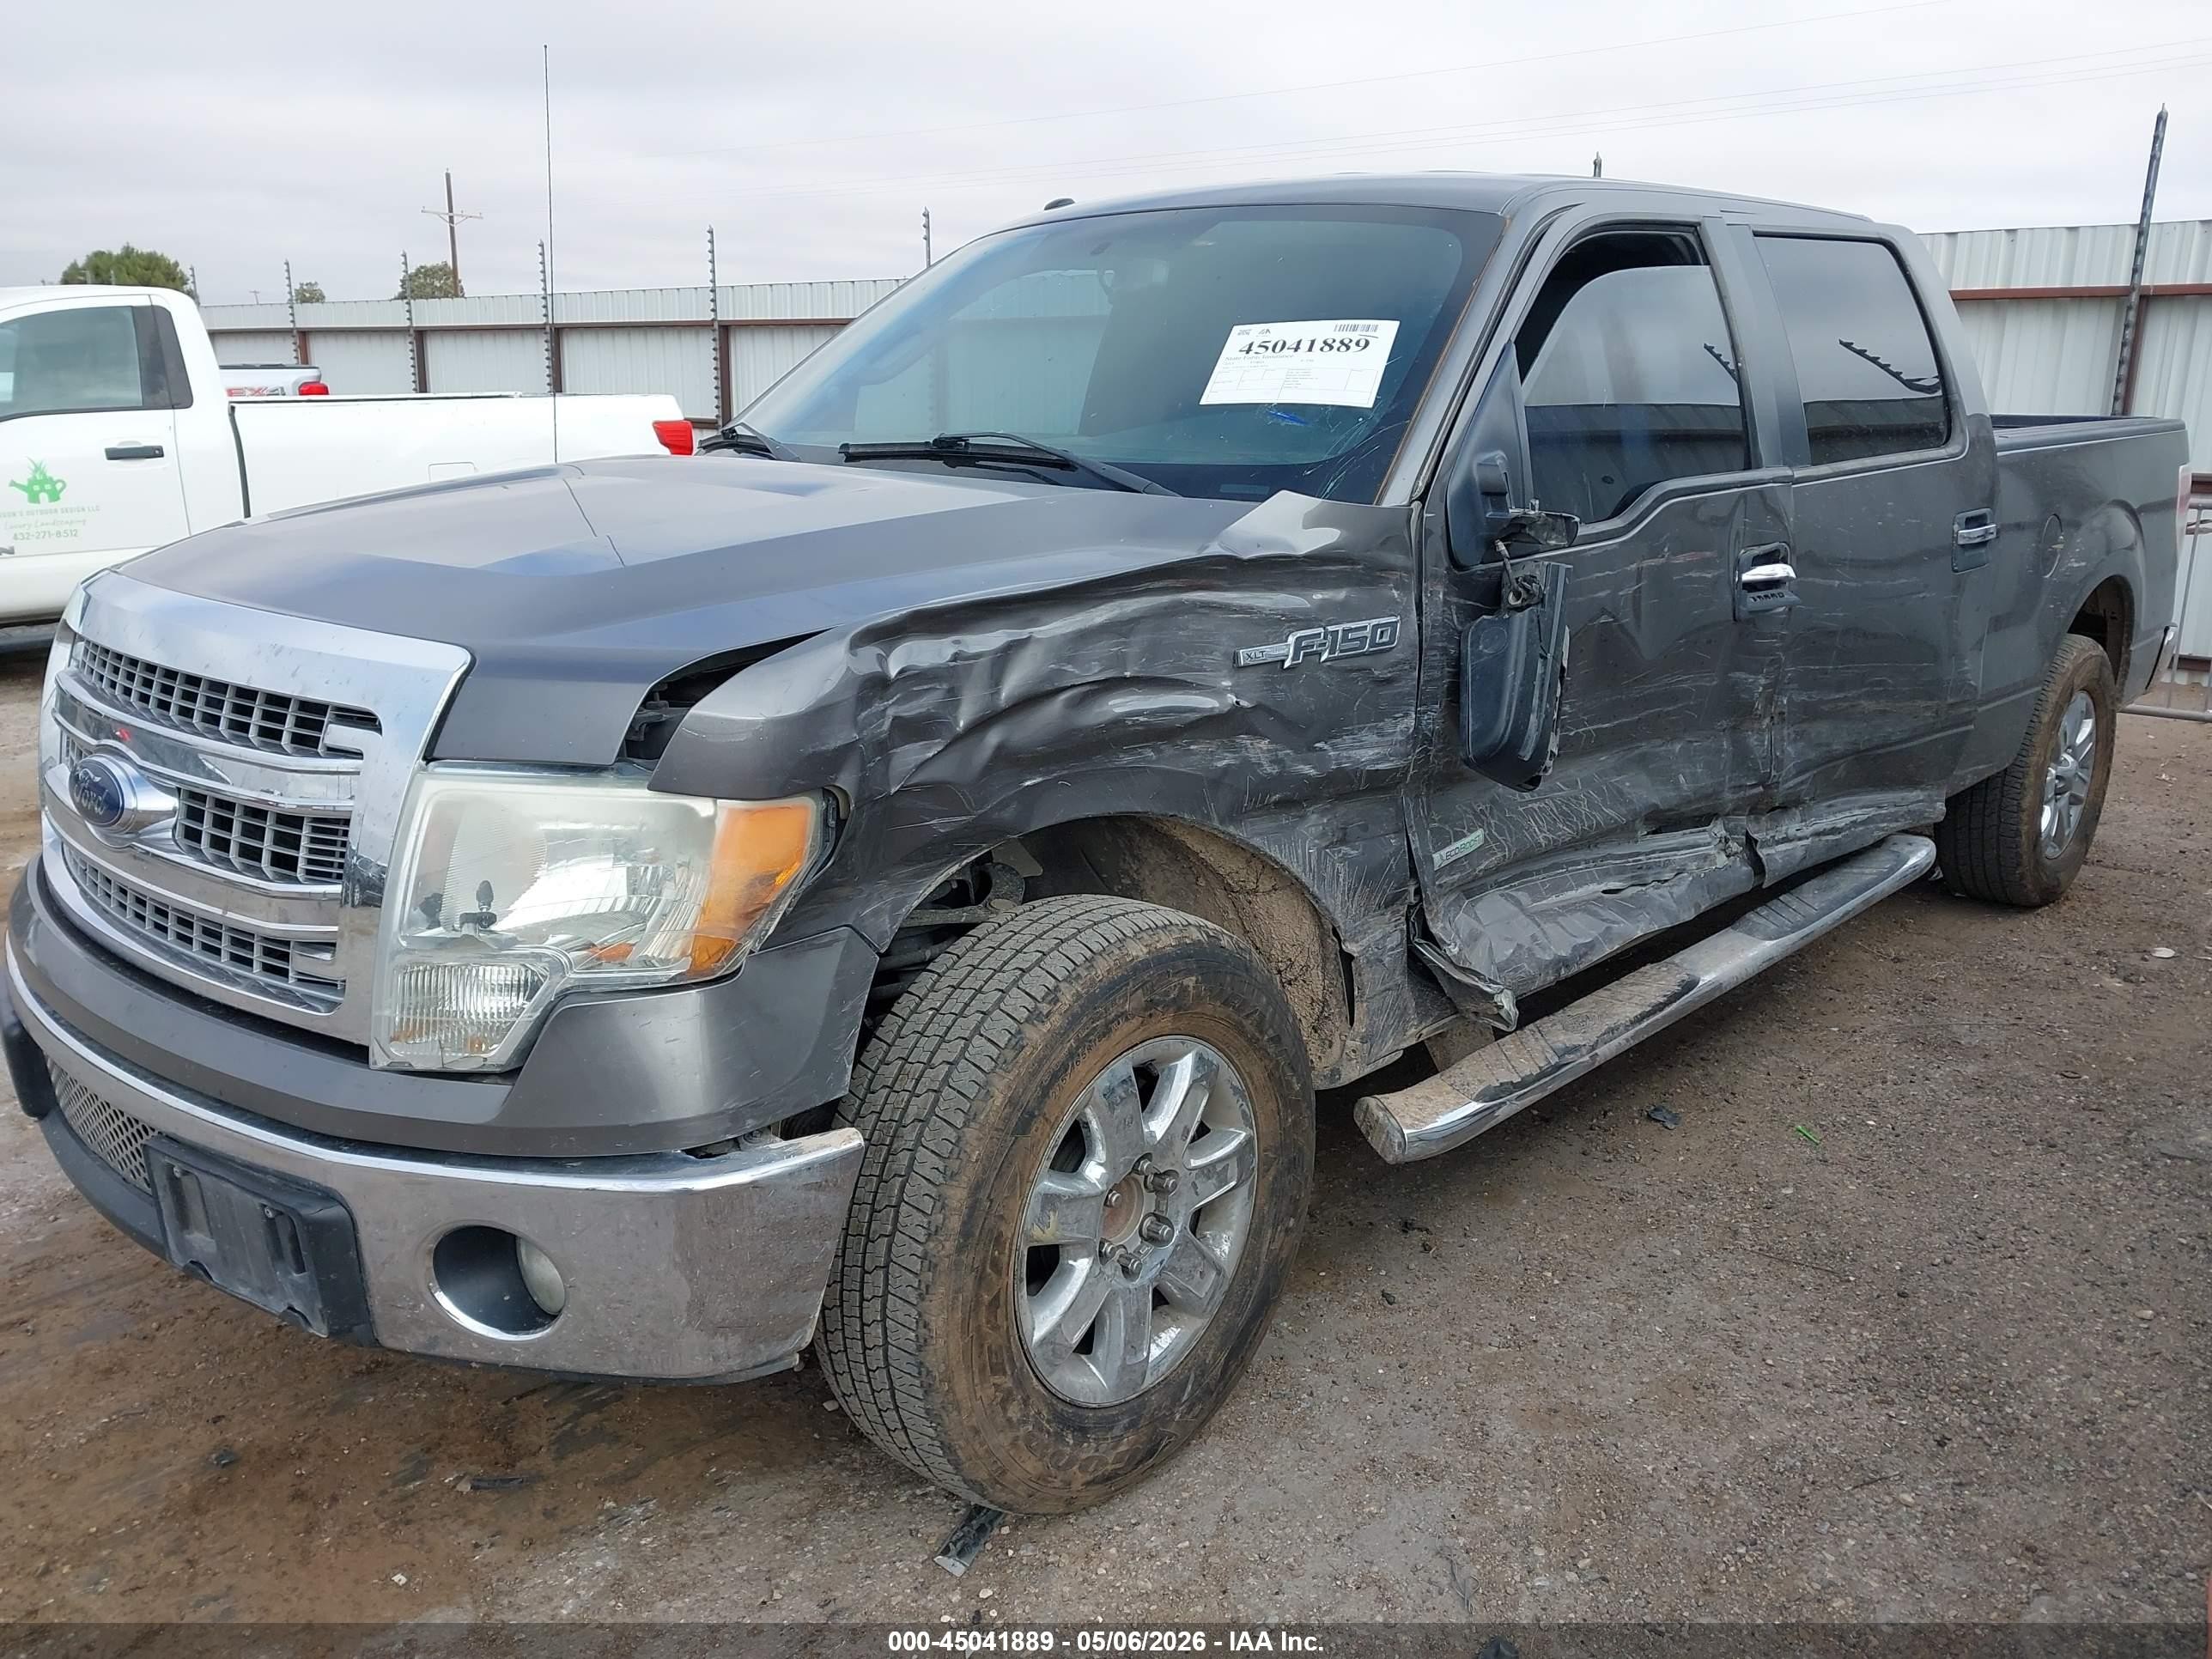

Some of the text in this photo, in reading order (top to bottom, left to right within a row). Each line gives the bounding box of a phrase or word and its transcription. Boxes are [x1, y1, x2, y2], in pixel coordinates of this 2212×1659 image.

[1238, 337, 1370, 355] 45041889
[13, 529, 78, 541] 432-271-8512
[1245, 615, 1401, 670] XLT F-150
[74, 767, 109, 816] Ford
